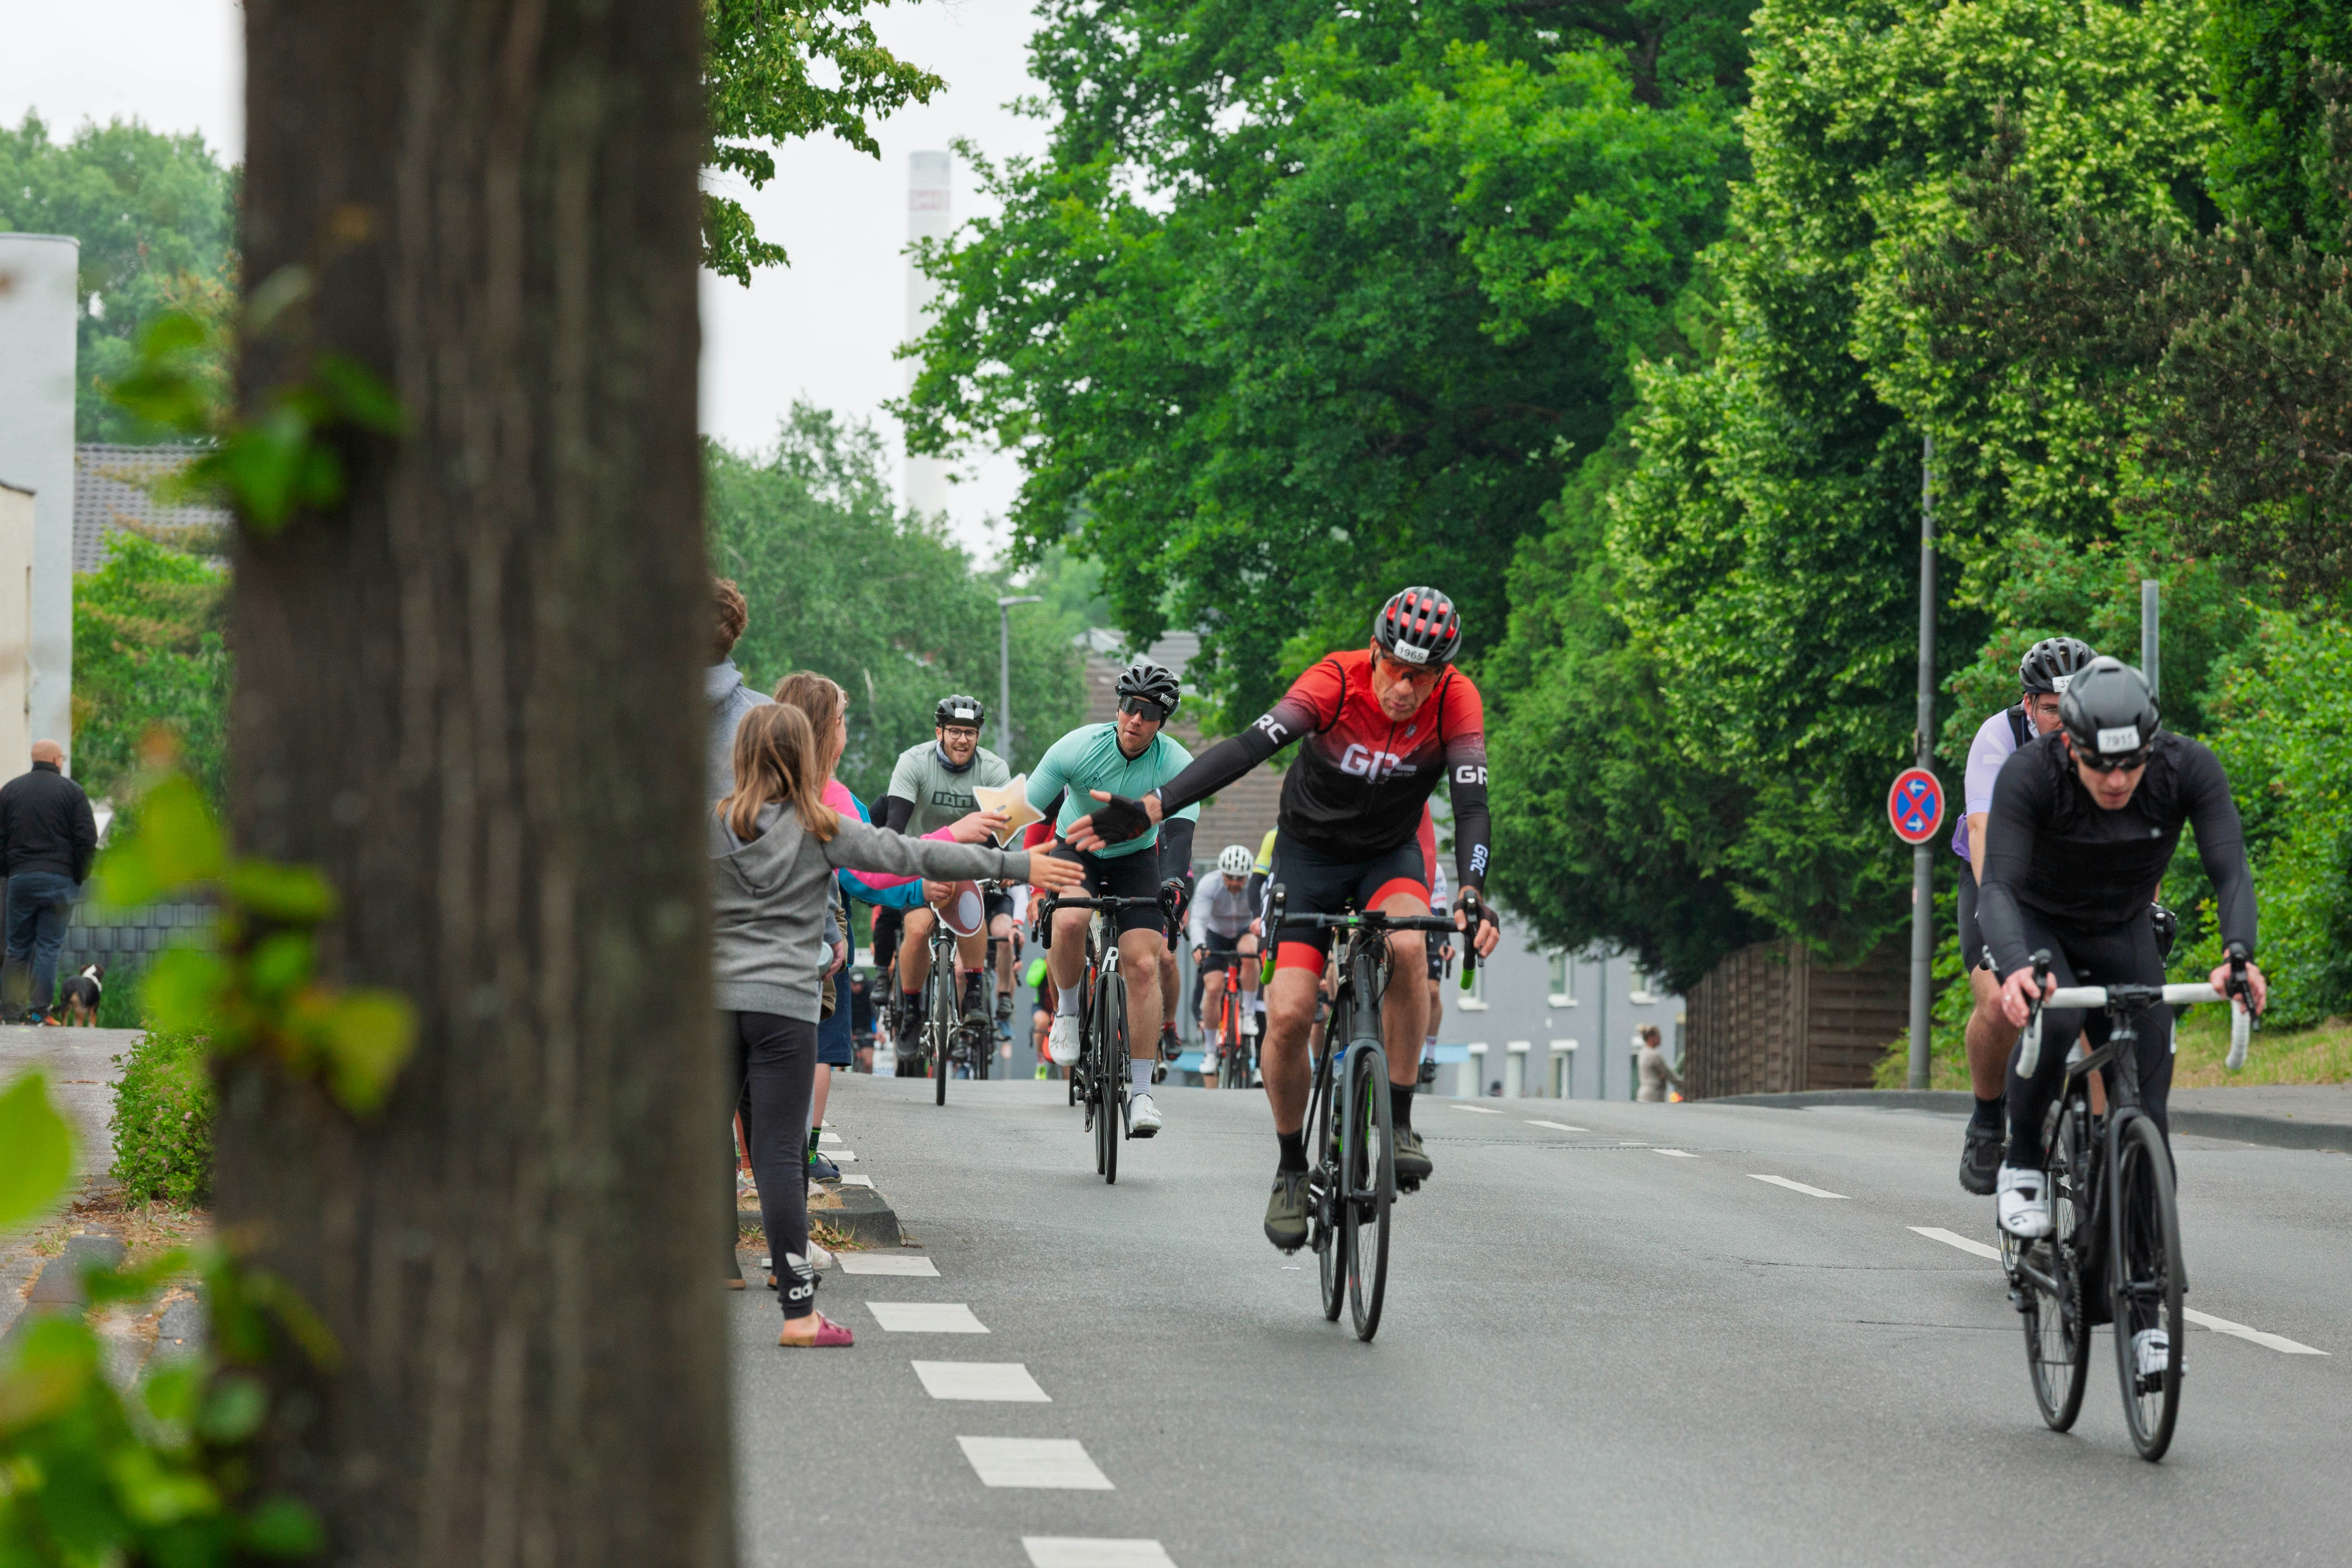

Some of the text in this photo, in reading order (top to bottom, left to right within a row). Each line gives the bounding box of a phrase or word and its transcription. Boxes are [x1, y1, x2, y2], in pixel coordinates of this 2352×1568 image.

[1400, 646, 1424, 660] 1965
[1161, 695, 1174, 706] 3632
[1470, 843, 1488, 877] GRC
[1101, 946, 1119, 972] R
